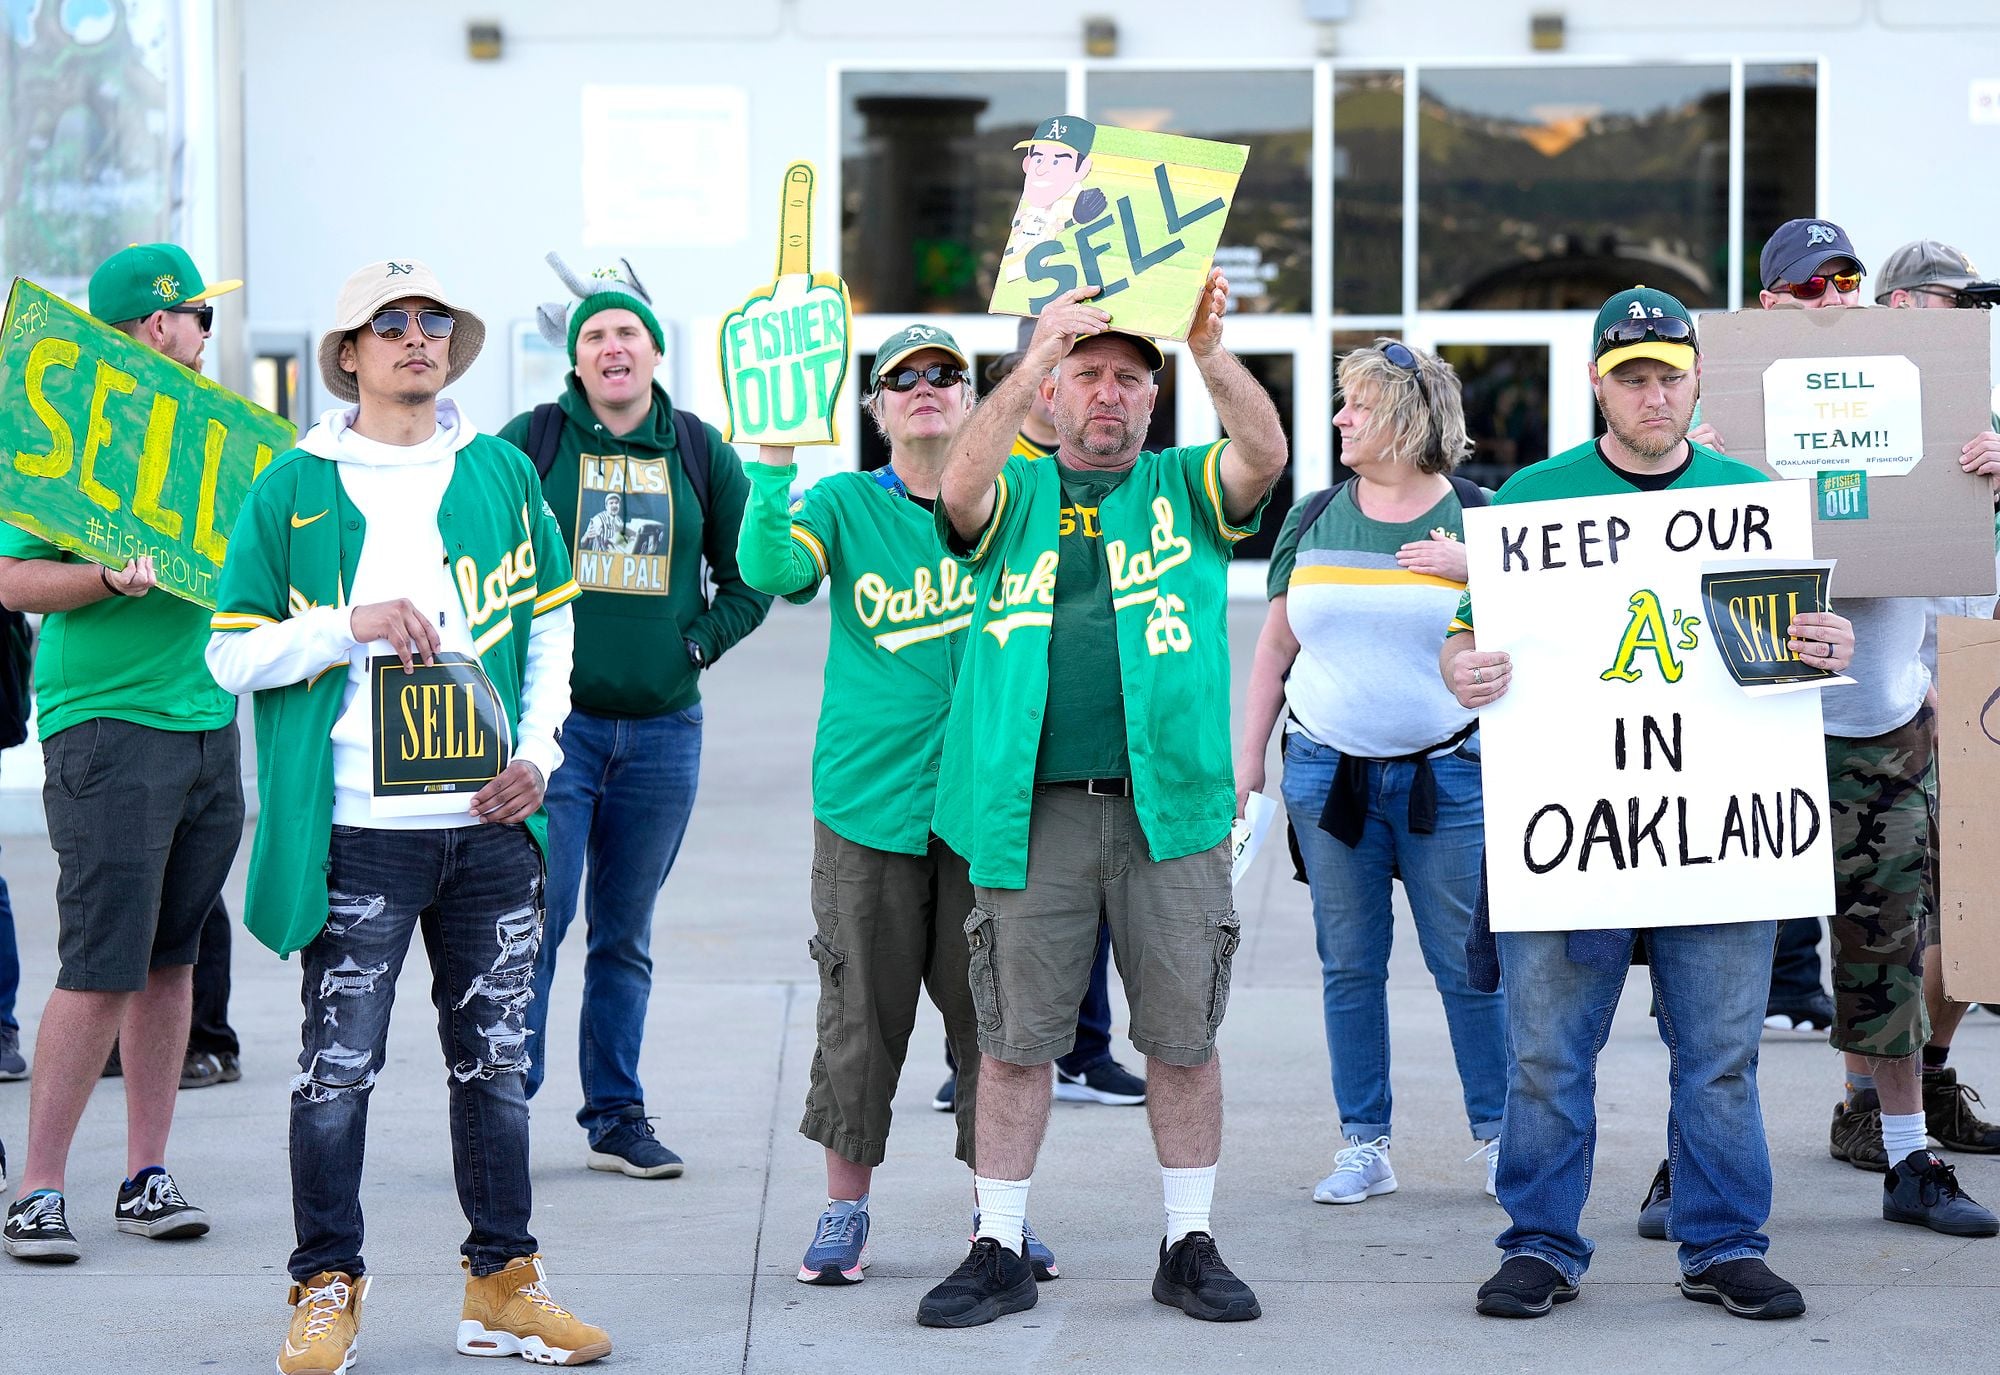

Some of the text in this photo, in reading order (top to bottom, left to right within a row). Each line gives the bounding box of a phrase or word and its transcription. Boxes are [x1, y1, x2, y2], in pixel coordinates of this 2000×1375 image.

[1044, 119, 1068, 141] A's
[1025, 163, 1225, 315] SELL
[13, 300, 50, 340] STAY
[729, 298, 843, 370] FISHER
[736, 348, 842, 436] OUT
[1806, 371, 1875, 390] SELL
[1813, 401, 1870, 419] THE
[1793, 429, 1889, 450] TEAM!!
[585, 460, 665, 492] HAL'S
[1825, 488, 1861, 517] OUT
[1499, 504, 1773, 572] KEEP OUR
[580, 552, 662, 590] MY PAL
[1145, 594, 1193, 656] 26
[1600, 588, 1701, 684] A's
[400, 683, 485, 761] SELL
[1614, 712, 1683, 772] IN
[1523, 787, 1821, 875] OAKLAND
